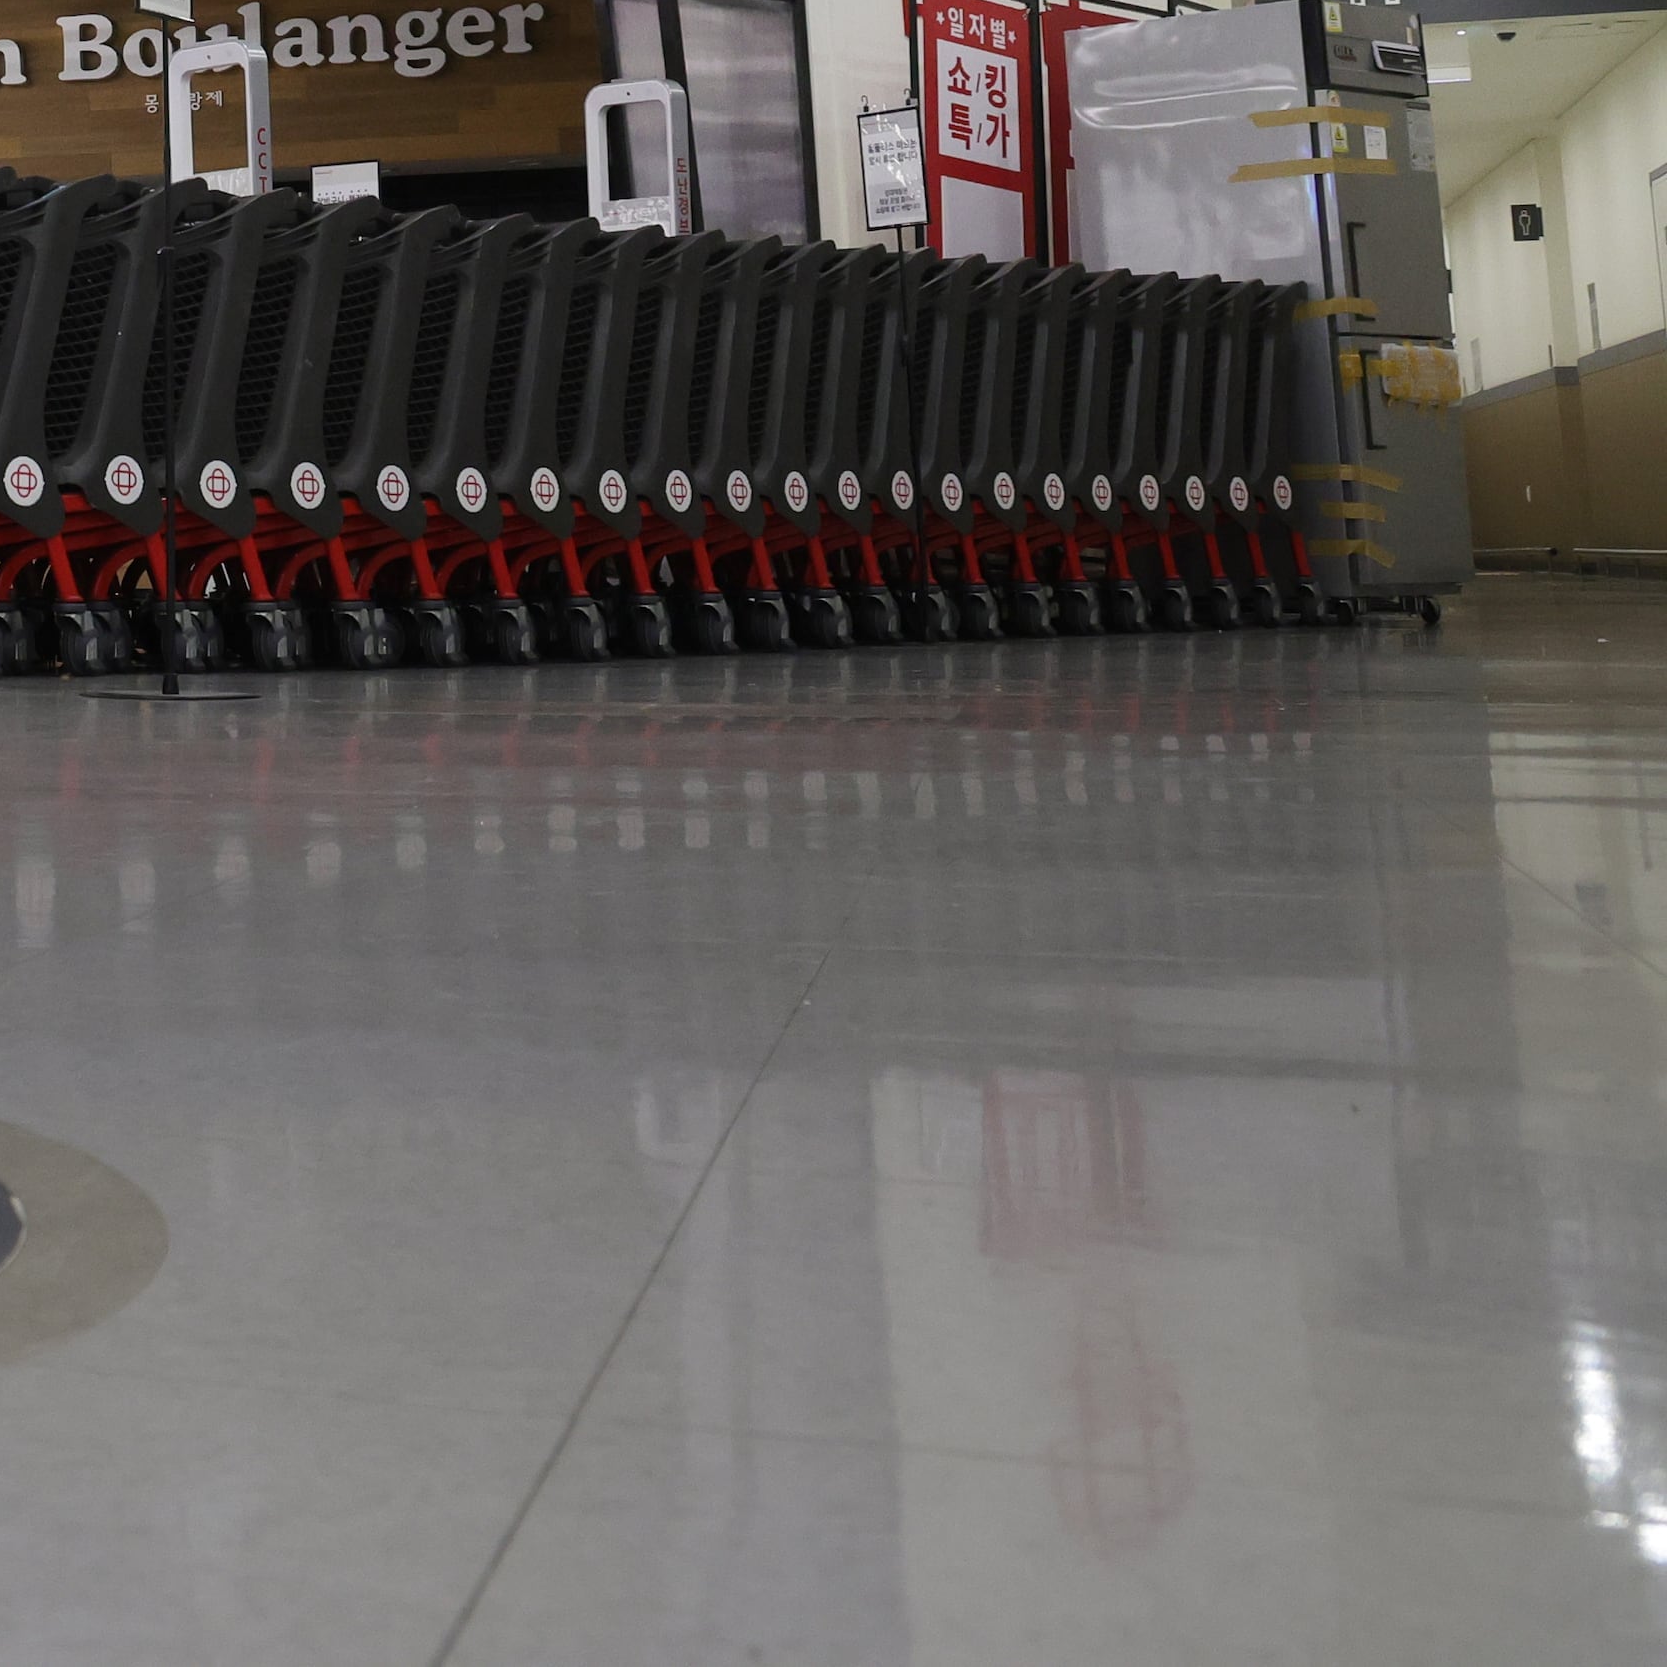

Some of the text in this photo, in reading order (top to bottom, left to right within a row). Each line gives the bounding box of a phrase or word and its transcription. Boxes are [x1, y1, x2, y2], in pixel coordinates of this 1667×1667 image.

[948, 7, 1007, 49] 일자별
[145, 90, 223, 113] 몽랑제
[257, 127, 267, 193] CCT
[676, 157, 690, 234] 도난경보
